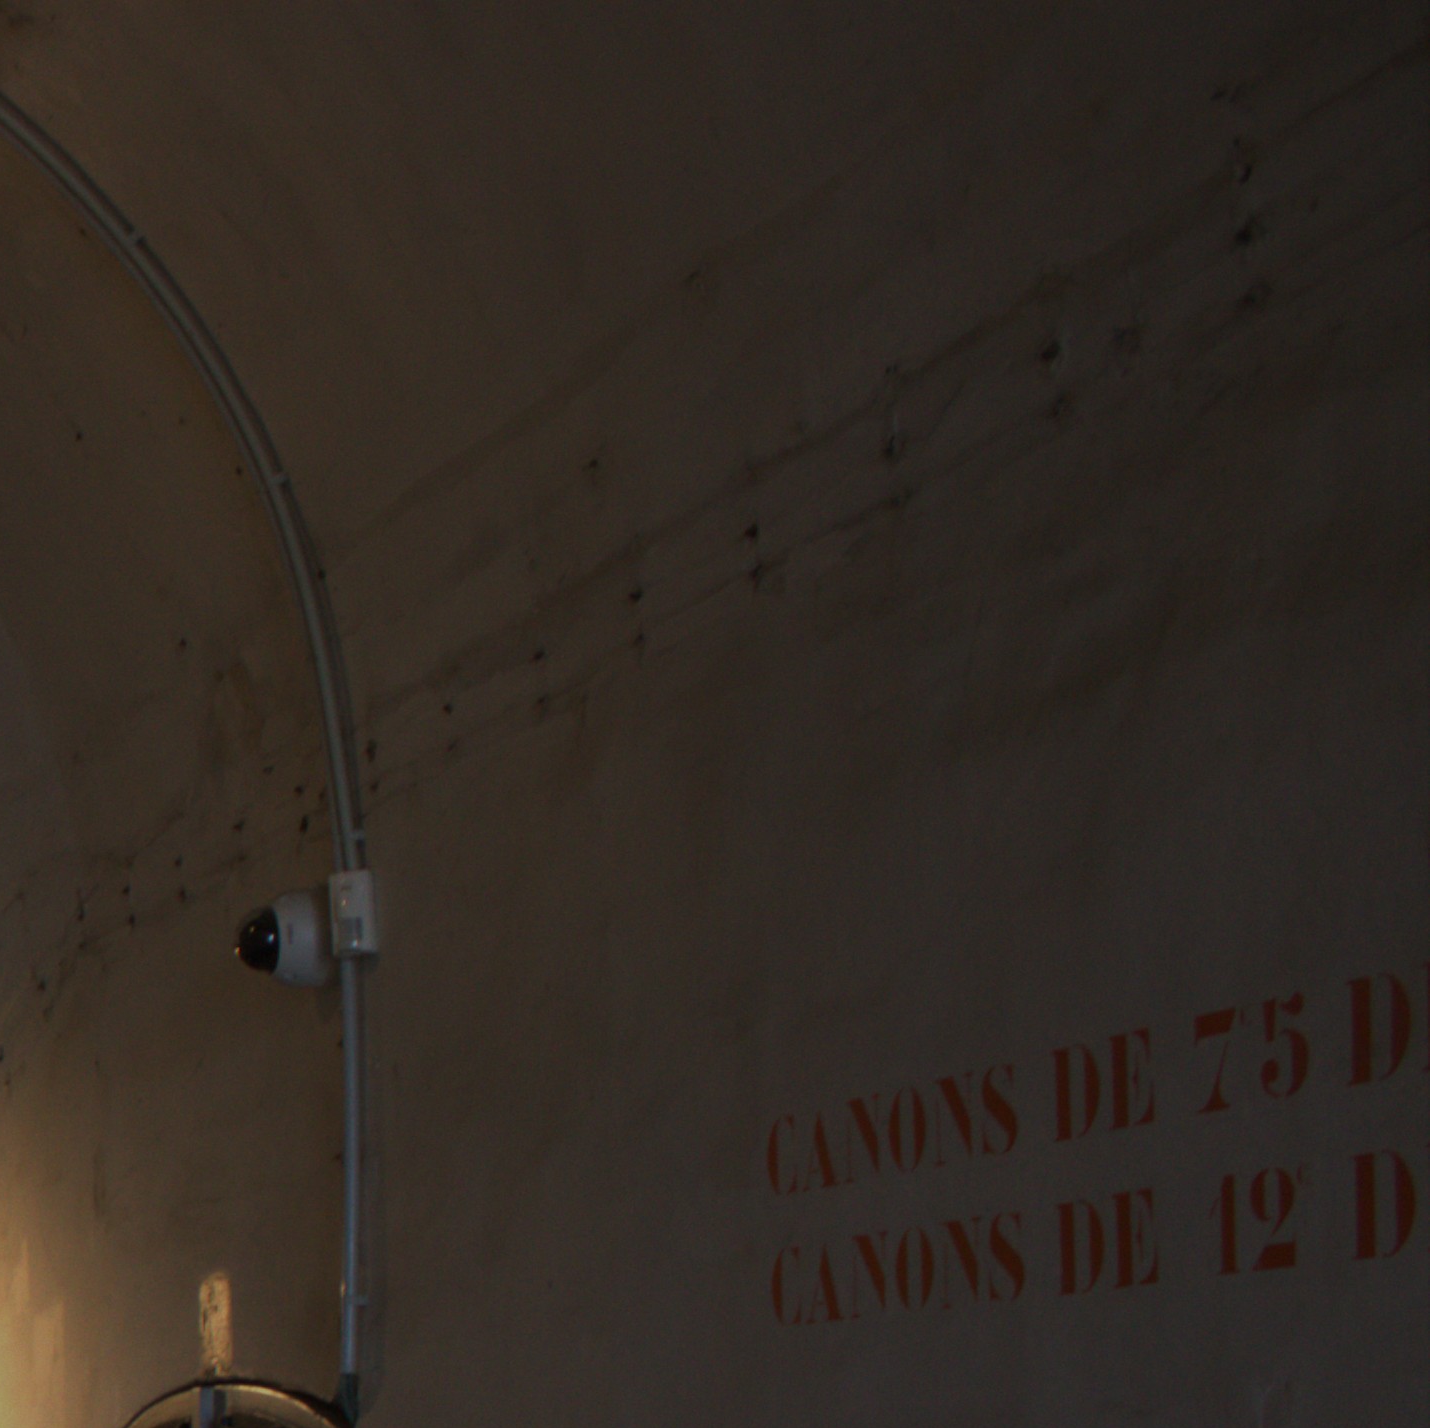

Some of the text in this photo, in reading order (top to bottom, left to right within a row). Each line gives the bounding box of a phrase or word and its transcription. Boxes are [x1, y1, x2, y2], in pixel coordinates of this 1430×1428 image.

[766, 1064, 1019, 1196] CANONS
[1052, 1026, 1156, 1142] DE
[1346, 960, 1430, 1088] D
[770, 1211, 1026, 1326] CANONS
[1057, 1188, 1159, 1297] DE
